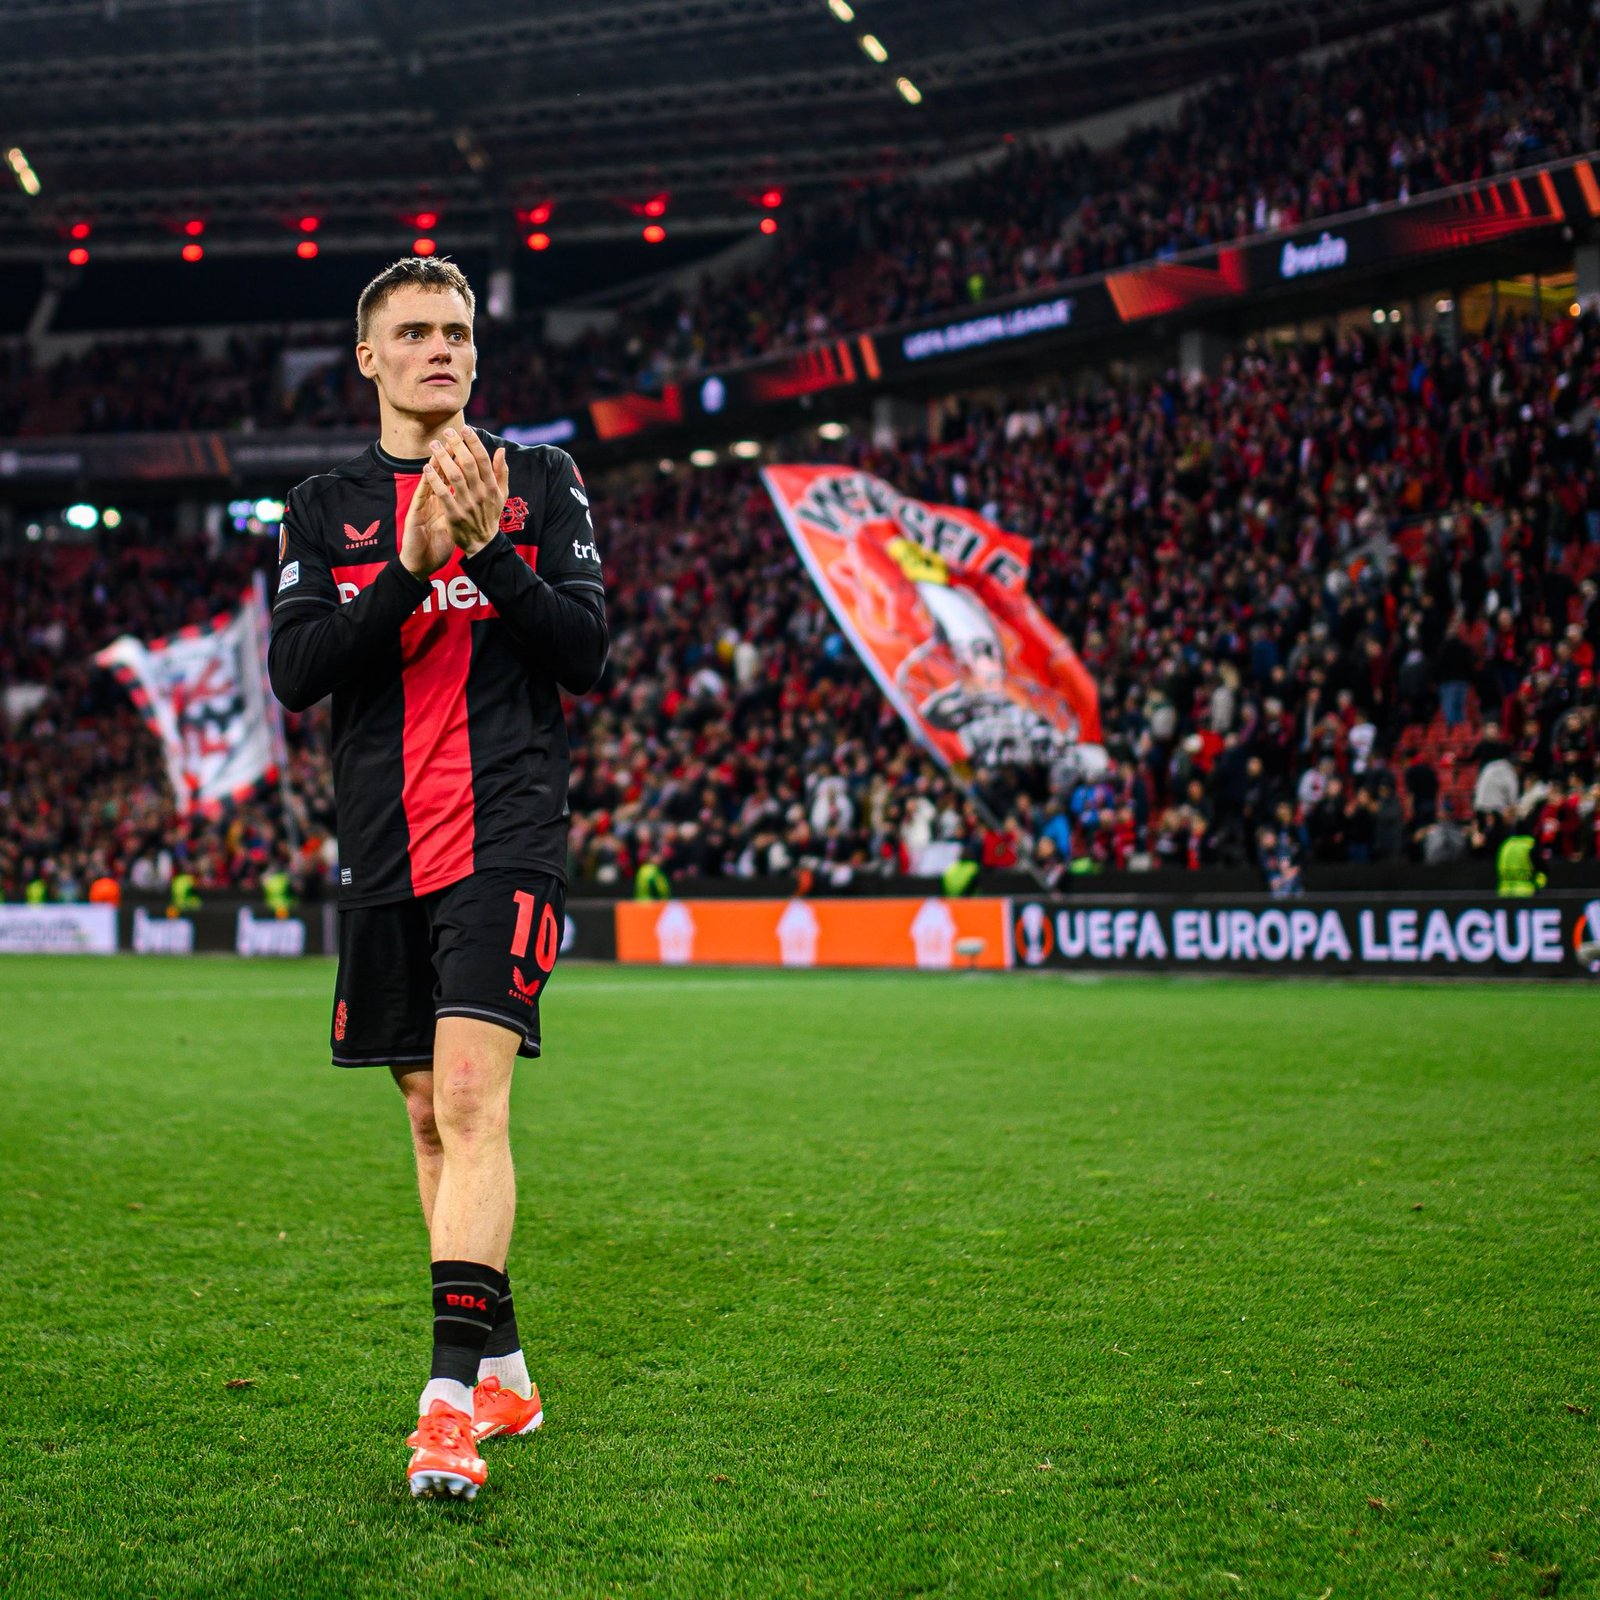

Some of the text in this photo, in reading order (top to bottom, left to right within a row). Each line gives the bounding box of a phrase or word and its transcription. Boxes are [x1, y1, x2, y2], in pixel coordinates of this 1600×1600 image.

[1281, 232, 1346, 277] bwin
[345, 538, 378, 550] CASTORE
[510, 890, 558, 973] 10
[1056, 908, 1565, 963] UEFA EUROPA LEAGUE
[446, 1294, 487, 1311] B04
